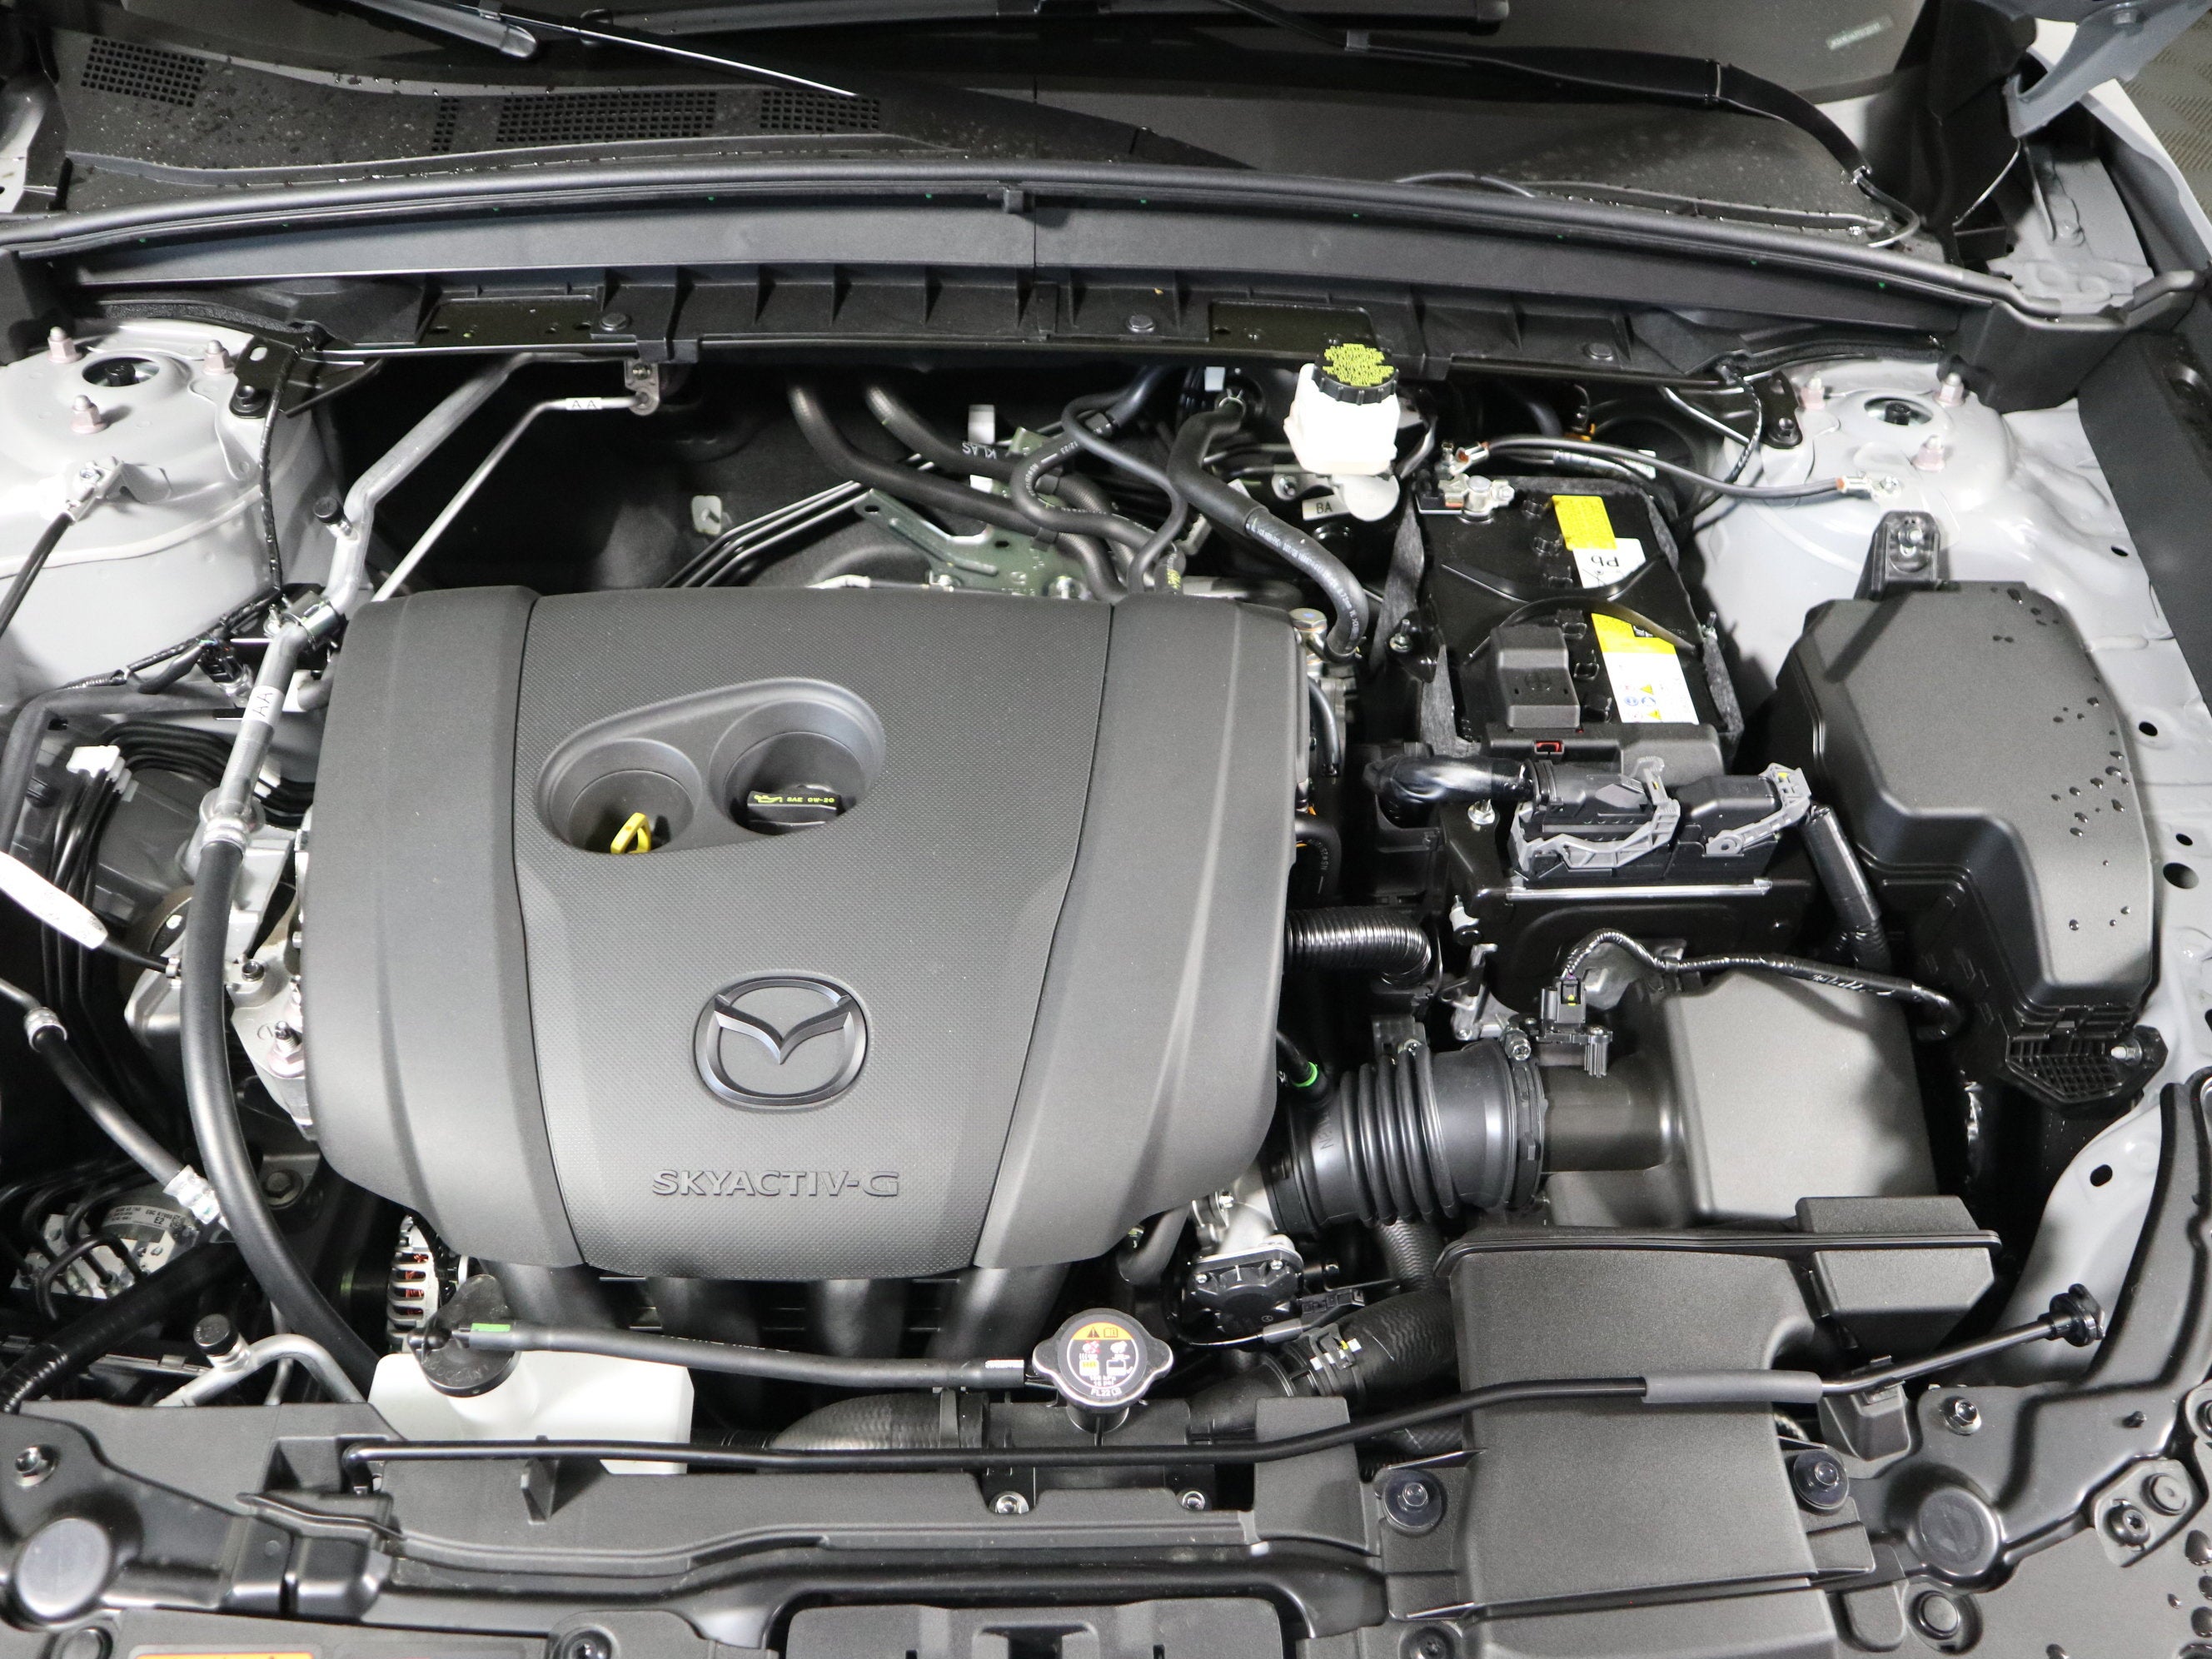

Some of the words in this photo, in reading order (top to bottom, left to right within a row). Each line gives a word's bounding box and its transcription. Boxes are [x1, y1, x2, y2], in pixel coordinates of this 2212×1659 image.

[1316, 501, 1333, 514] BA
[1591, 555, 1619, 567] Pb
[252, 692, 274, 717] AA
[651, 1169, 899, 1197] SKYACTIV-G
[153, 1217, 165, 1225] E2
[1090, 1387, 1111, 1397] FL22
